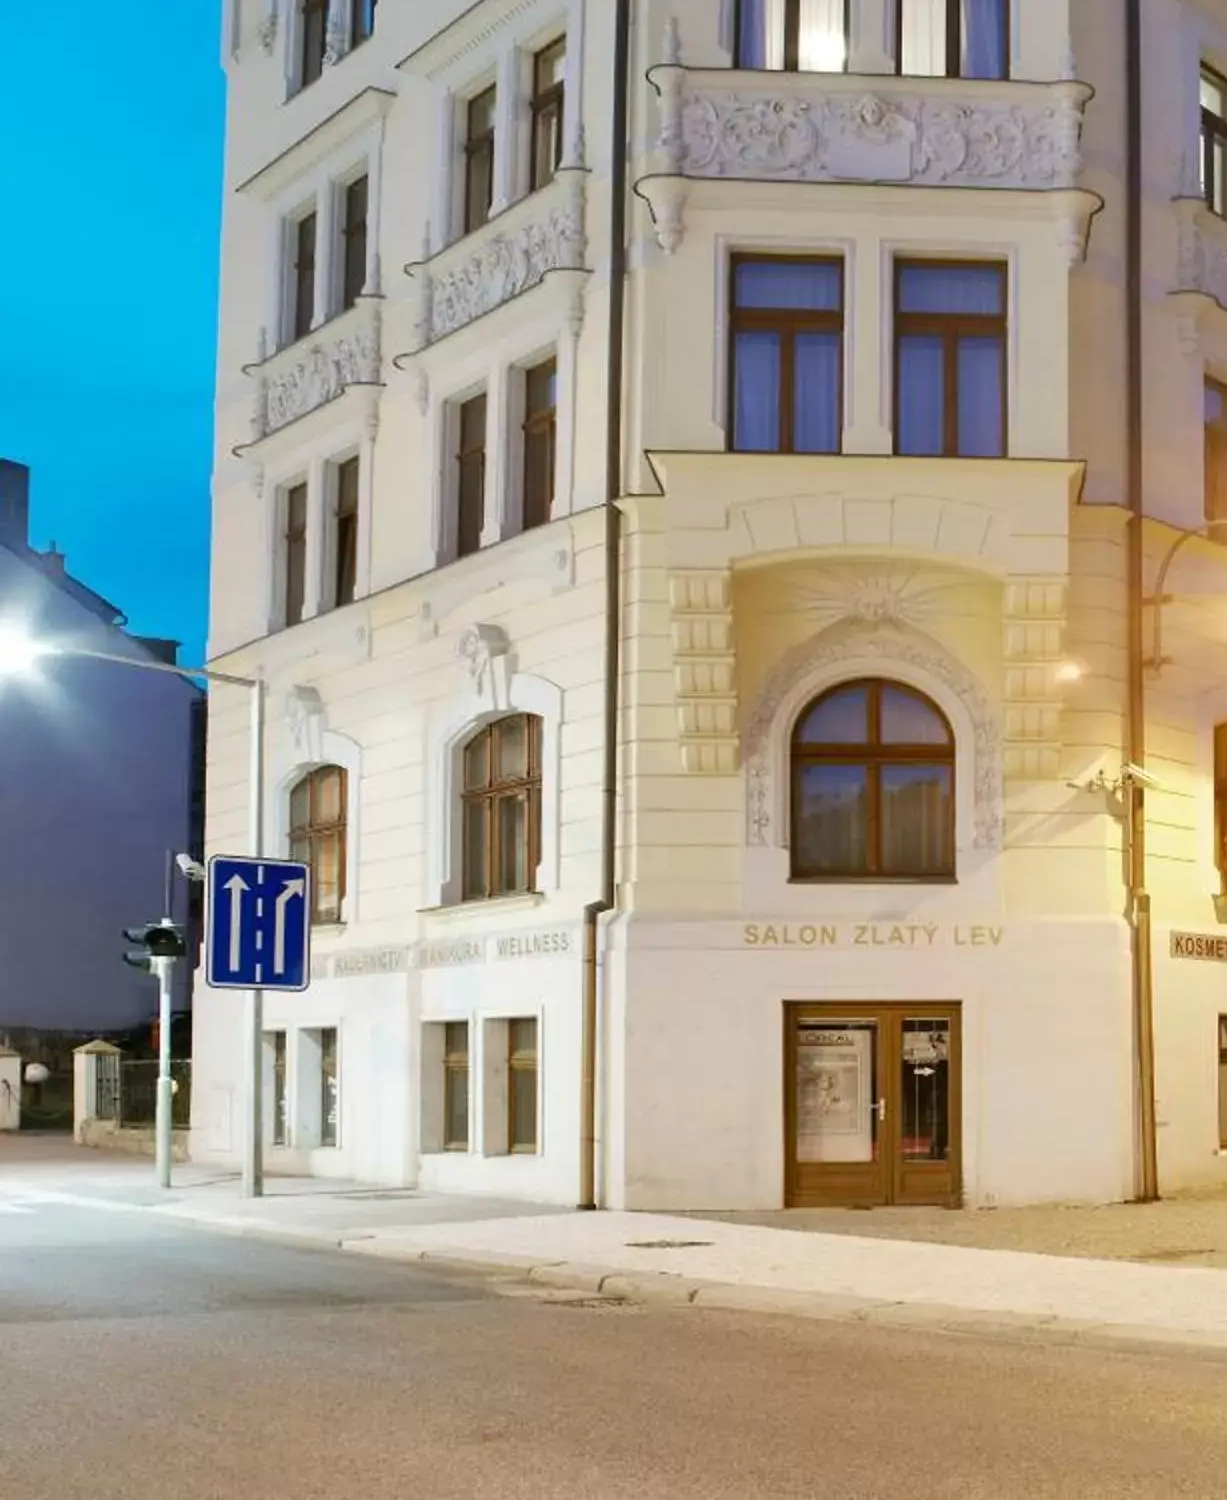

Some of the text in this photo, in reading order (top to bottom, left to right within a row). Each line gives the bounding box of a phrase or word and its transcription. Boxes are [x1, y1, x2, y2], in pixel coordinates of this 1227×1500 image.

[497, 931, 570, 958] WELLNESS
[743, 920, 1004, 946] SALON ZLATÝ LEV
